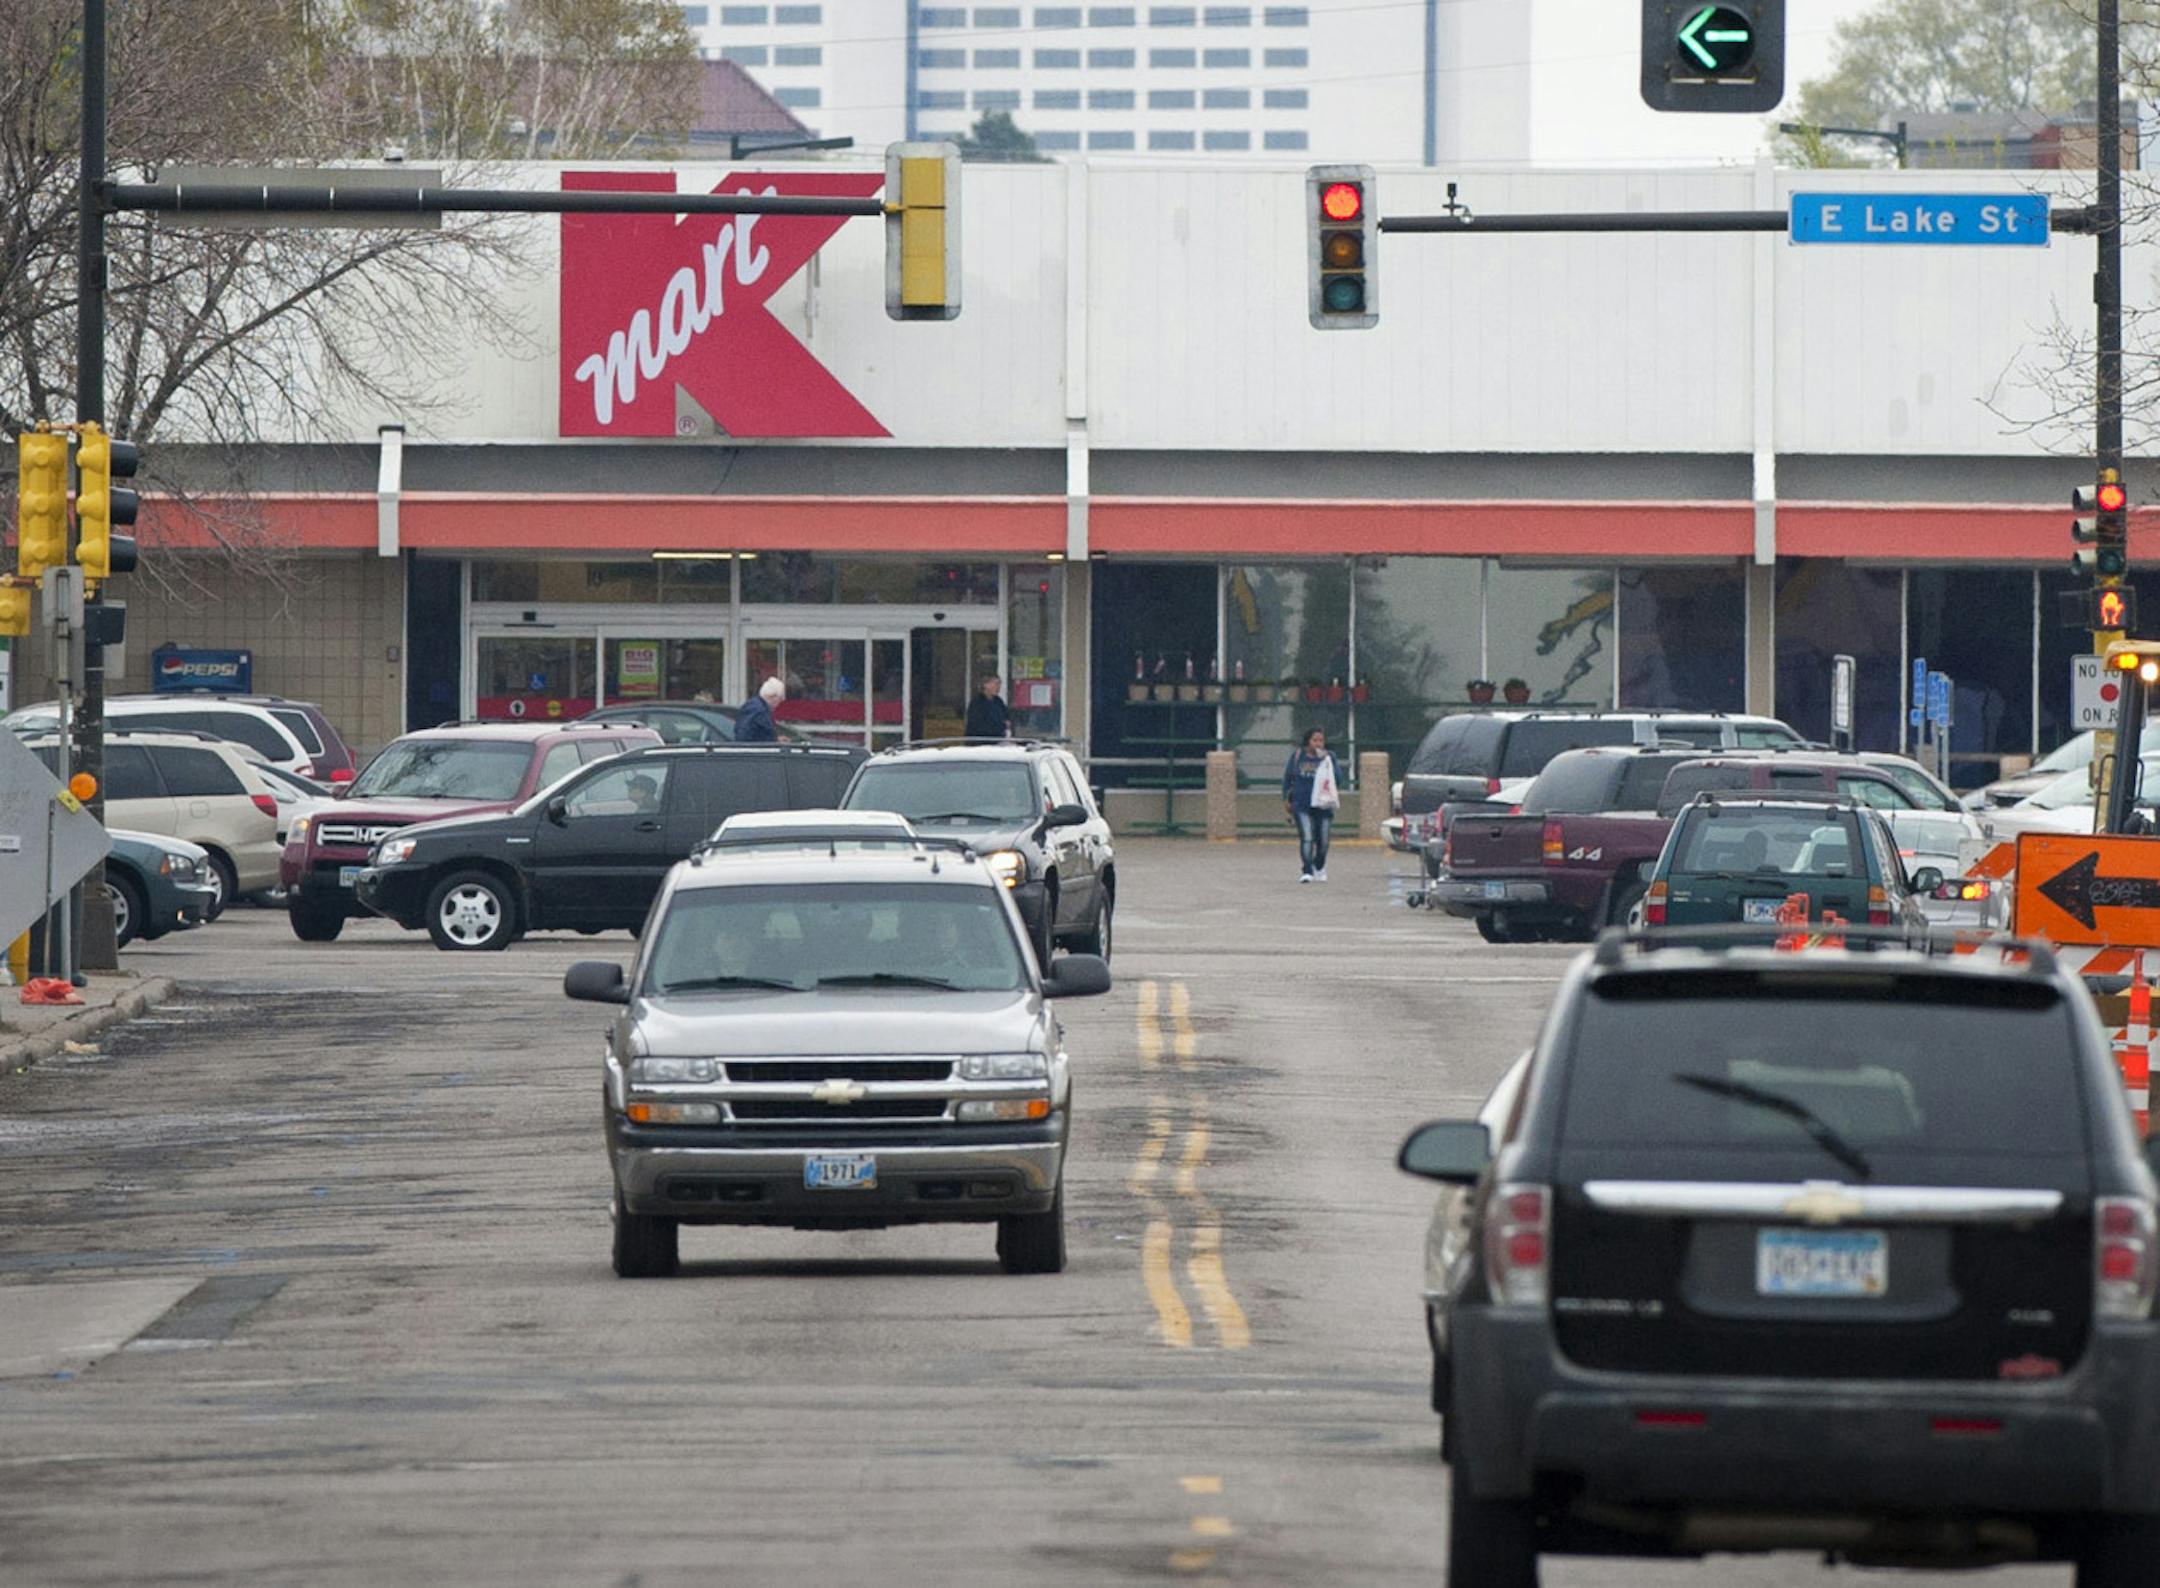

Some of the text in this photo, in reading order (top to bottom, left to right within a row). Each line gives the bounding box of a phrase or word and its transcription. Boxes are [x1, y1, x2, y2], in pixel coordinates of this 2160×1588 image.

[1821, 205, 2018, 233] E Lake St
[183, 663, 239, 676] PEPSI
[2079, 664, 2097, 678] NO
[2083, 708, 2101, 722] ON
[823, 1164, 856, 1180] 1971
